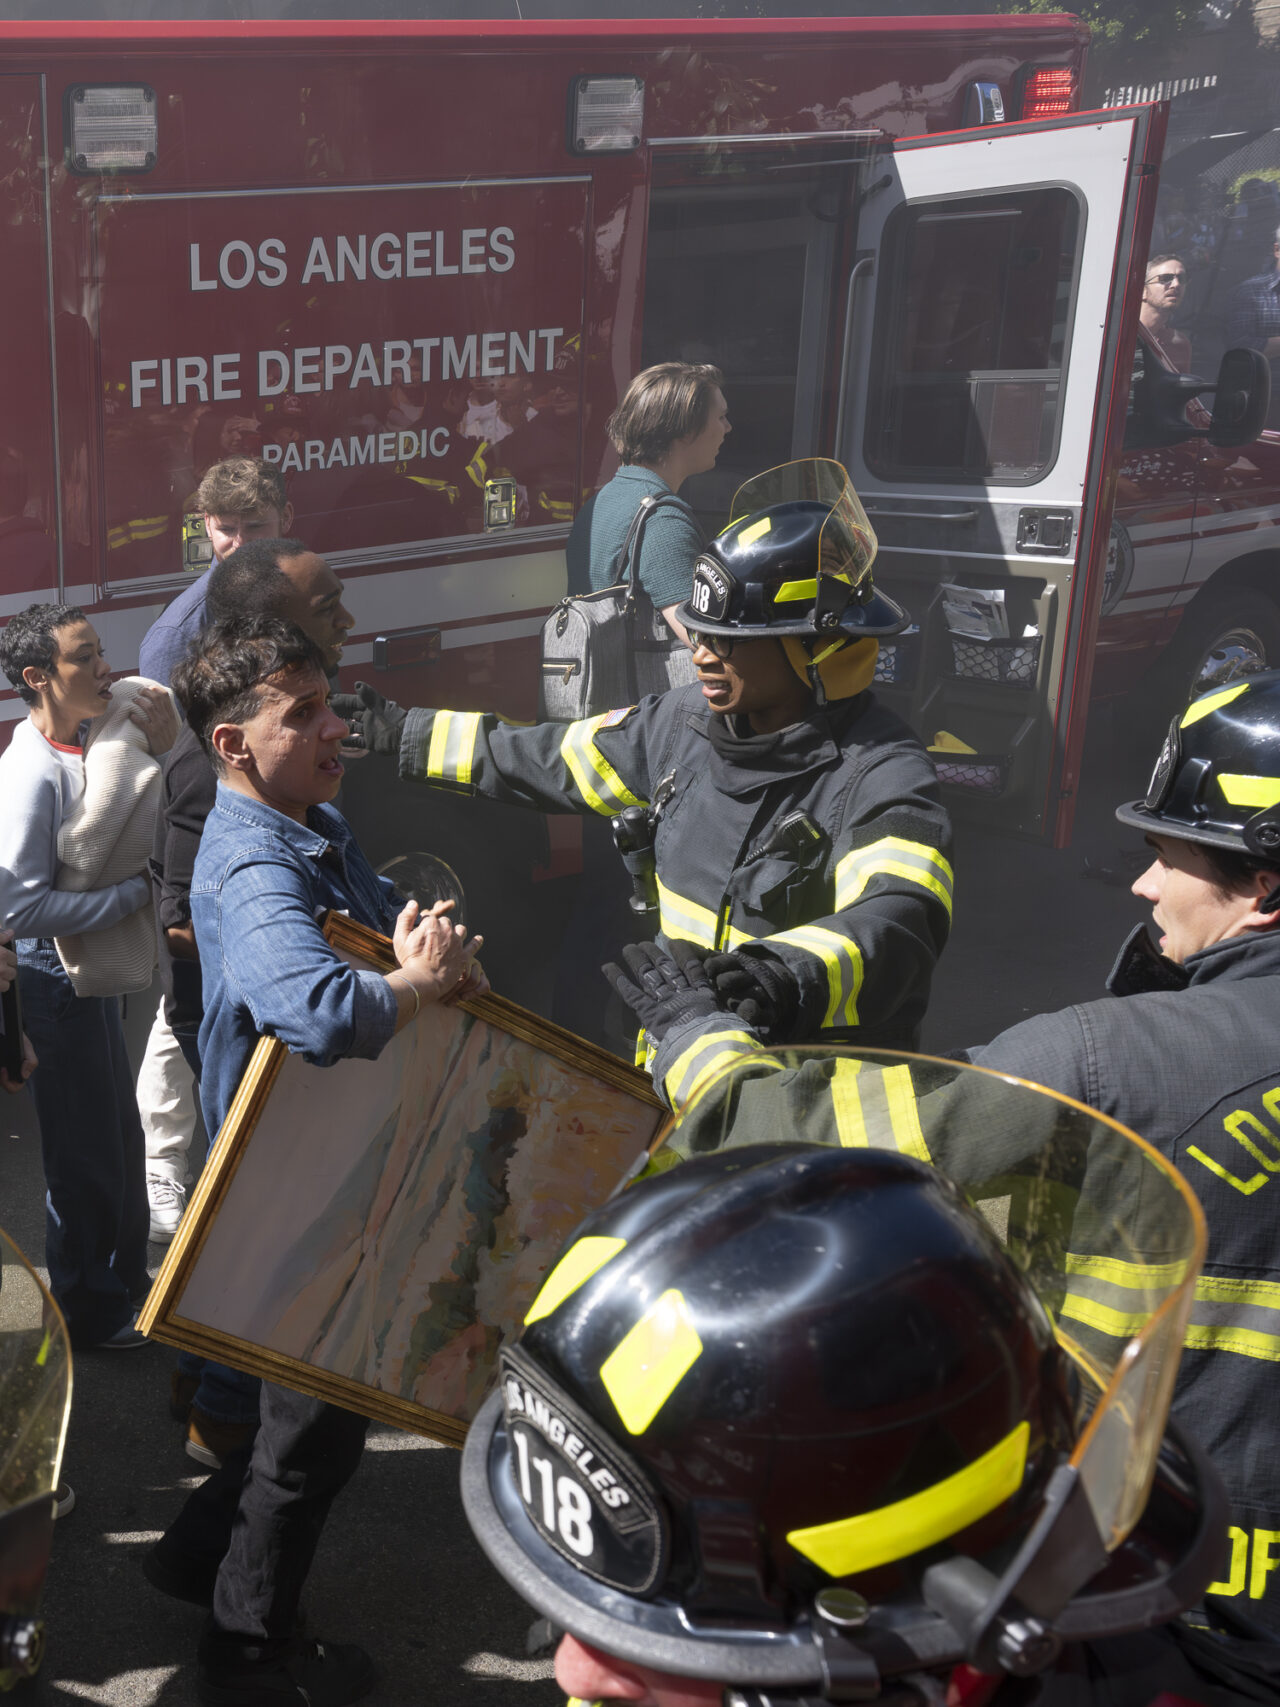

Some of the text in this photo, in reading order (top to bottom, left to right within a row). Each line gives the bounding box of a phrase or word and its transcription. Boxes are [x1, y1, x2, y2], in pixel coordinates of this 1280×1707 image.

[190, 226, 516, 292] LOS ANGELES
[130, 327, 564, 409] FIRE DEPARTMENT
[262, 426, 451, 474] PARAMEDIC
[692, 579, 711, 613] 118
[512, 1429, 594, 1557] 118
